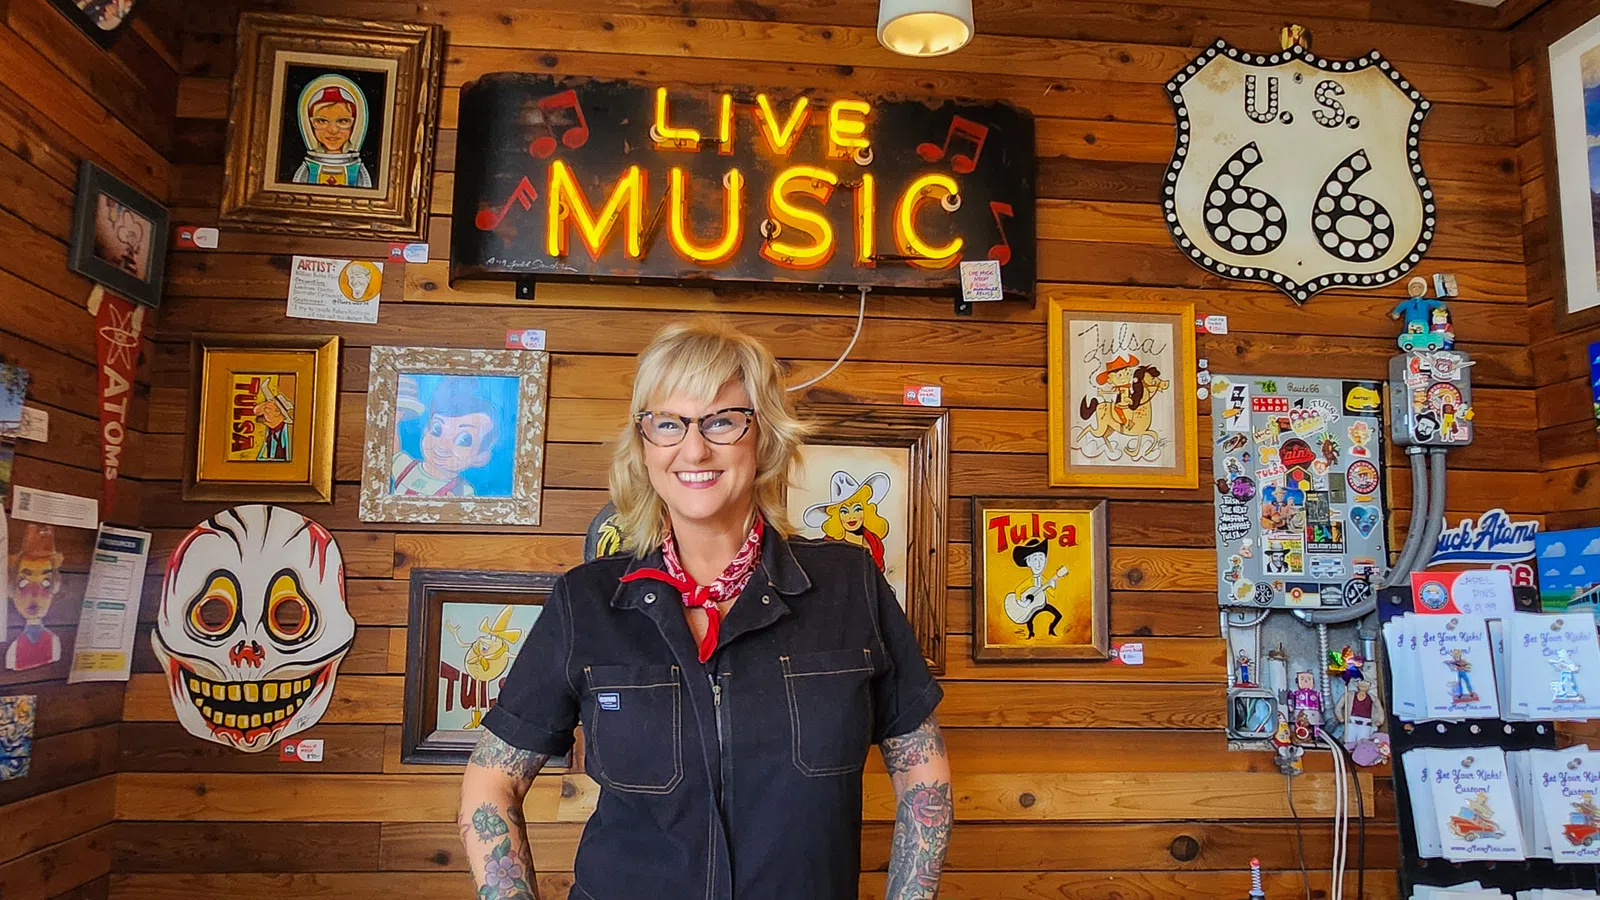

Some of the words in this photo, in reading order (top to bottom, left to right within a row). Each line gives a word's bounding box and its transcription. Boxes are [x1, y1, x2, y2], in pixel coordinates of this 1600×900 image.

[653, 86, 872, 160] LIVE
[546, 160, 964, 270] MUSIC
[1203, 140, 1394, 263] 66
[297, 259, 336, 273] ARTIST:
[1078, 323, 1166, 363] Tulsa
[103, 365, 130, 481] ATOMS
[231, 377, 261, 453] TULSA
[1310, 400, 1339, 422] TULSA
[989, 514, 1079, 553] Tulsa
[1437, 522, 1473, 551] uck
[1473, 512, 1537, 550] Atoms
[1473, 589, 1497, 599] PINS
[1423, 631, 1436, 647] Get
[1437, 632, 1458, 646] Your
[1523, 633, 1538, 647] Get
[1540, 632, 1562, 647] Your
[1436, 769, 1450, 784] Get
[1452, 769, 1474, 784] Your
[1476, 769, 1502, 781] Kicks!
[1455, 784, 1490, 794] Custom!
[1542, 772, 1557, 787] Get
[1558, 771, 1582, 787] Your
